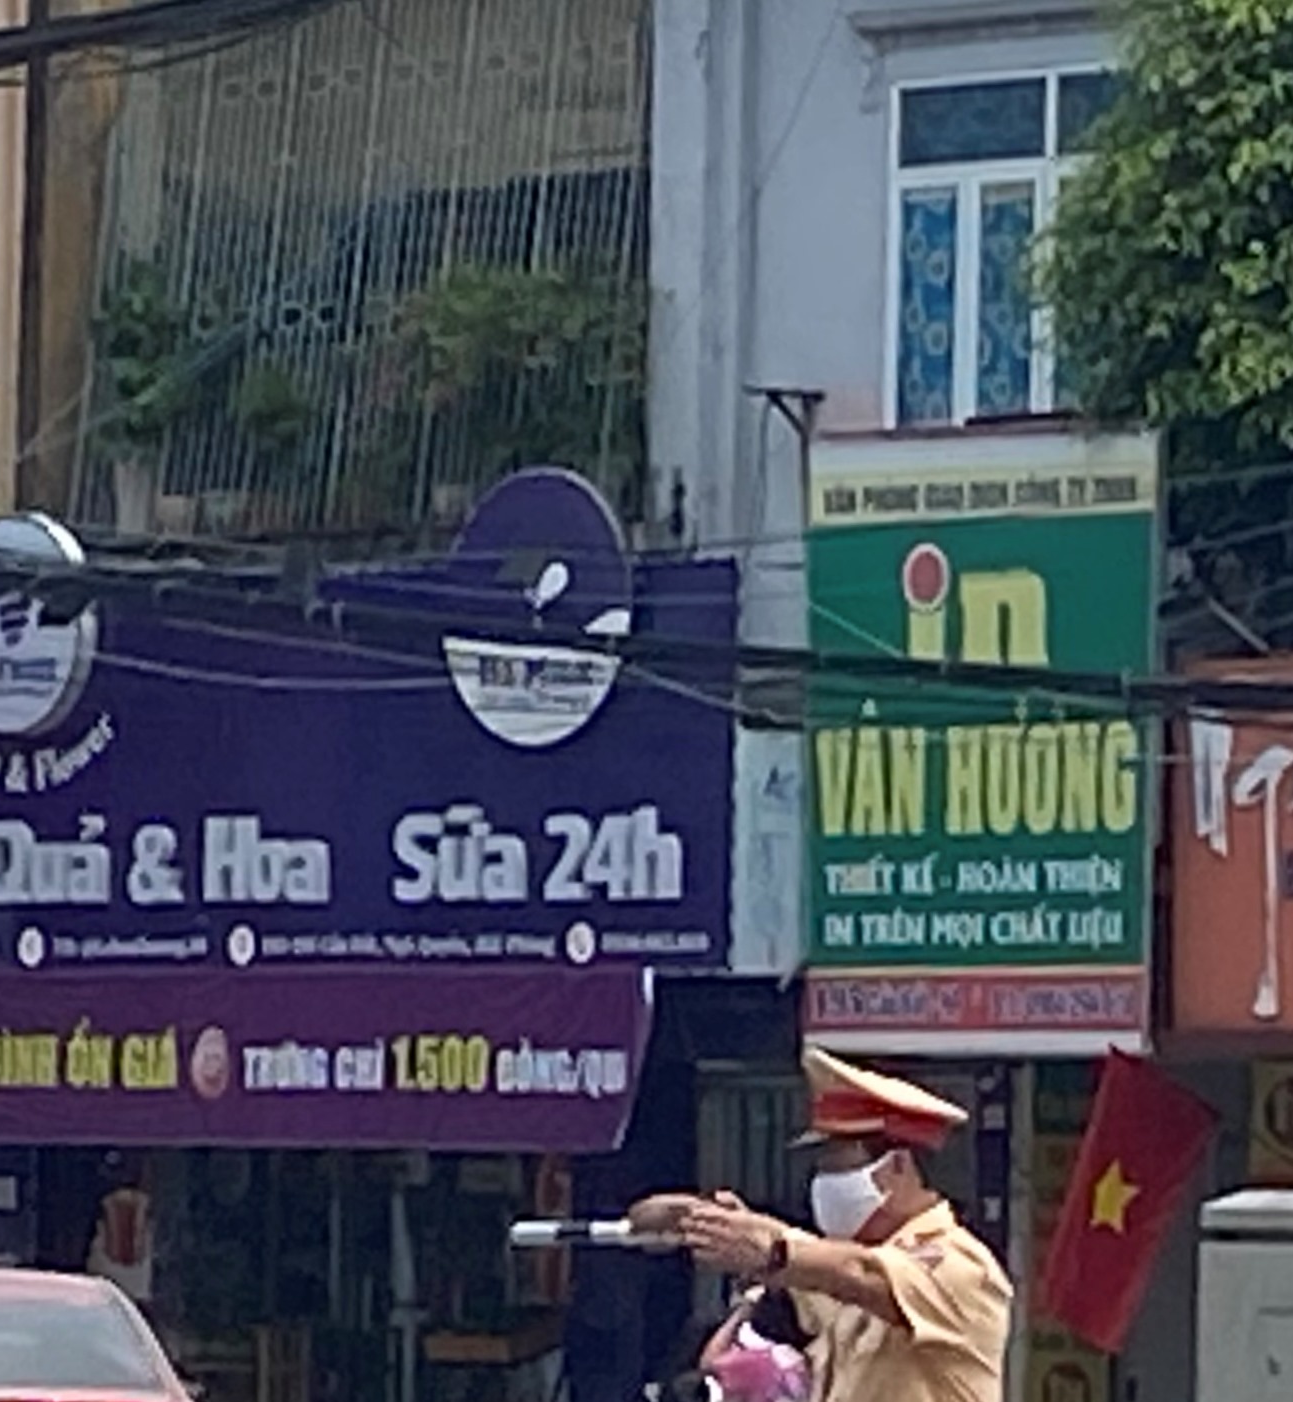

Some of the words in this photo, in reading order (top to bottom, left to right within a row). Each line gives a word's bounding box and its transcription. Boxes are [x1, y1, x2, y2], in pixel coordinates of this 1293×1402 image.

[127, 824, 185, 905] &
[202, 815, 333, 903] Hoa
[392, 803, 529, 903] Sữa
[543, 804, 683, 902] 24h
[391, 1034, 491, 1094] 1.500
